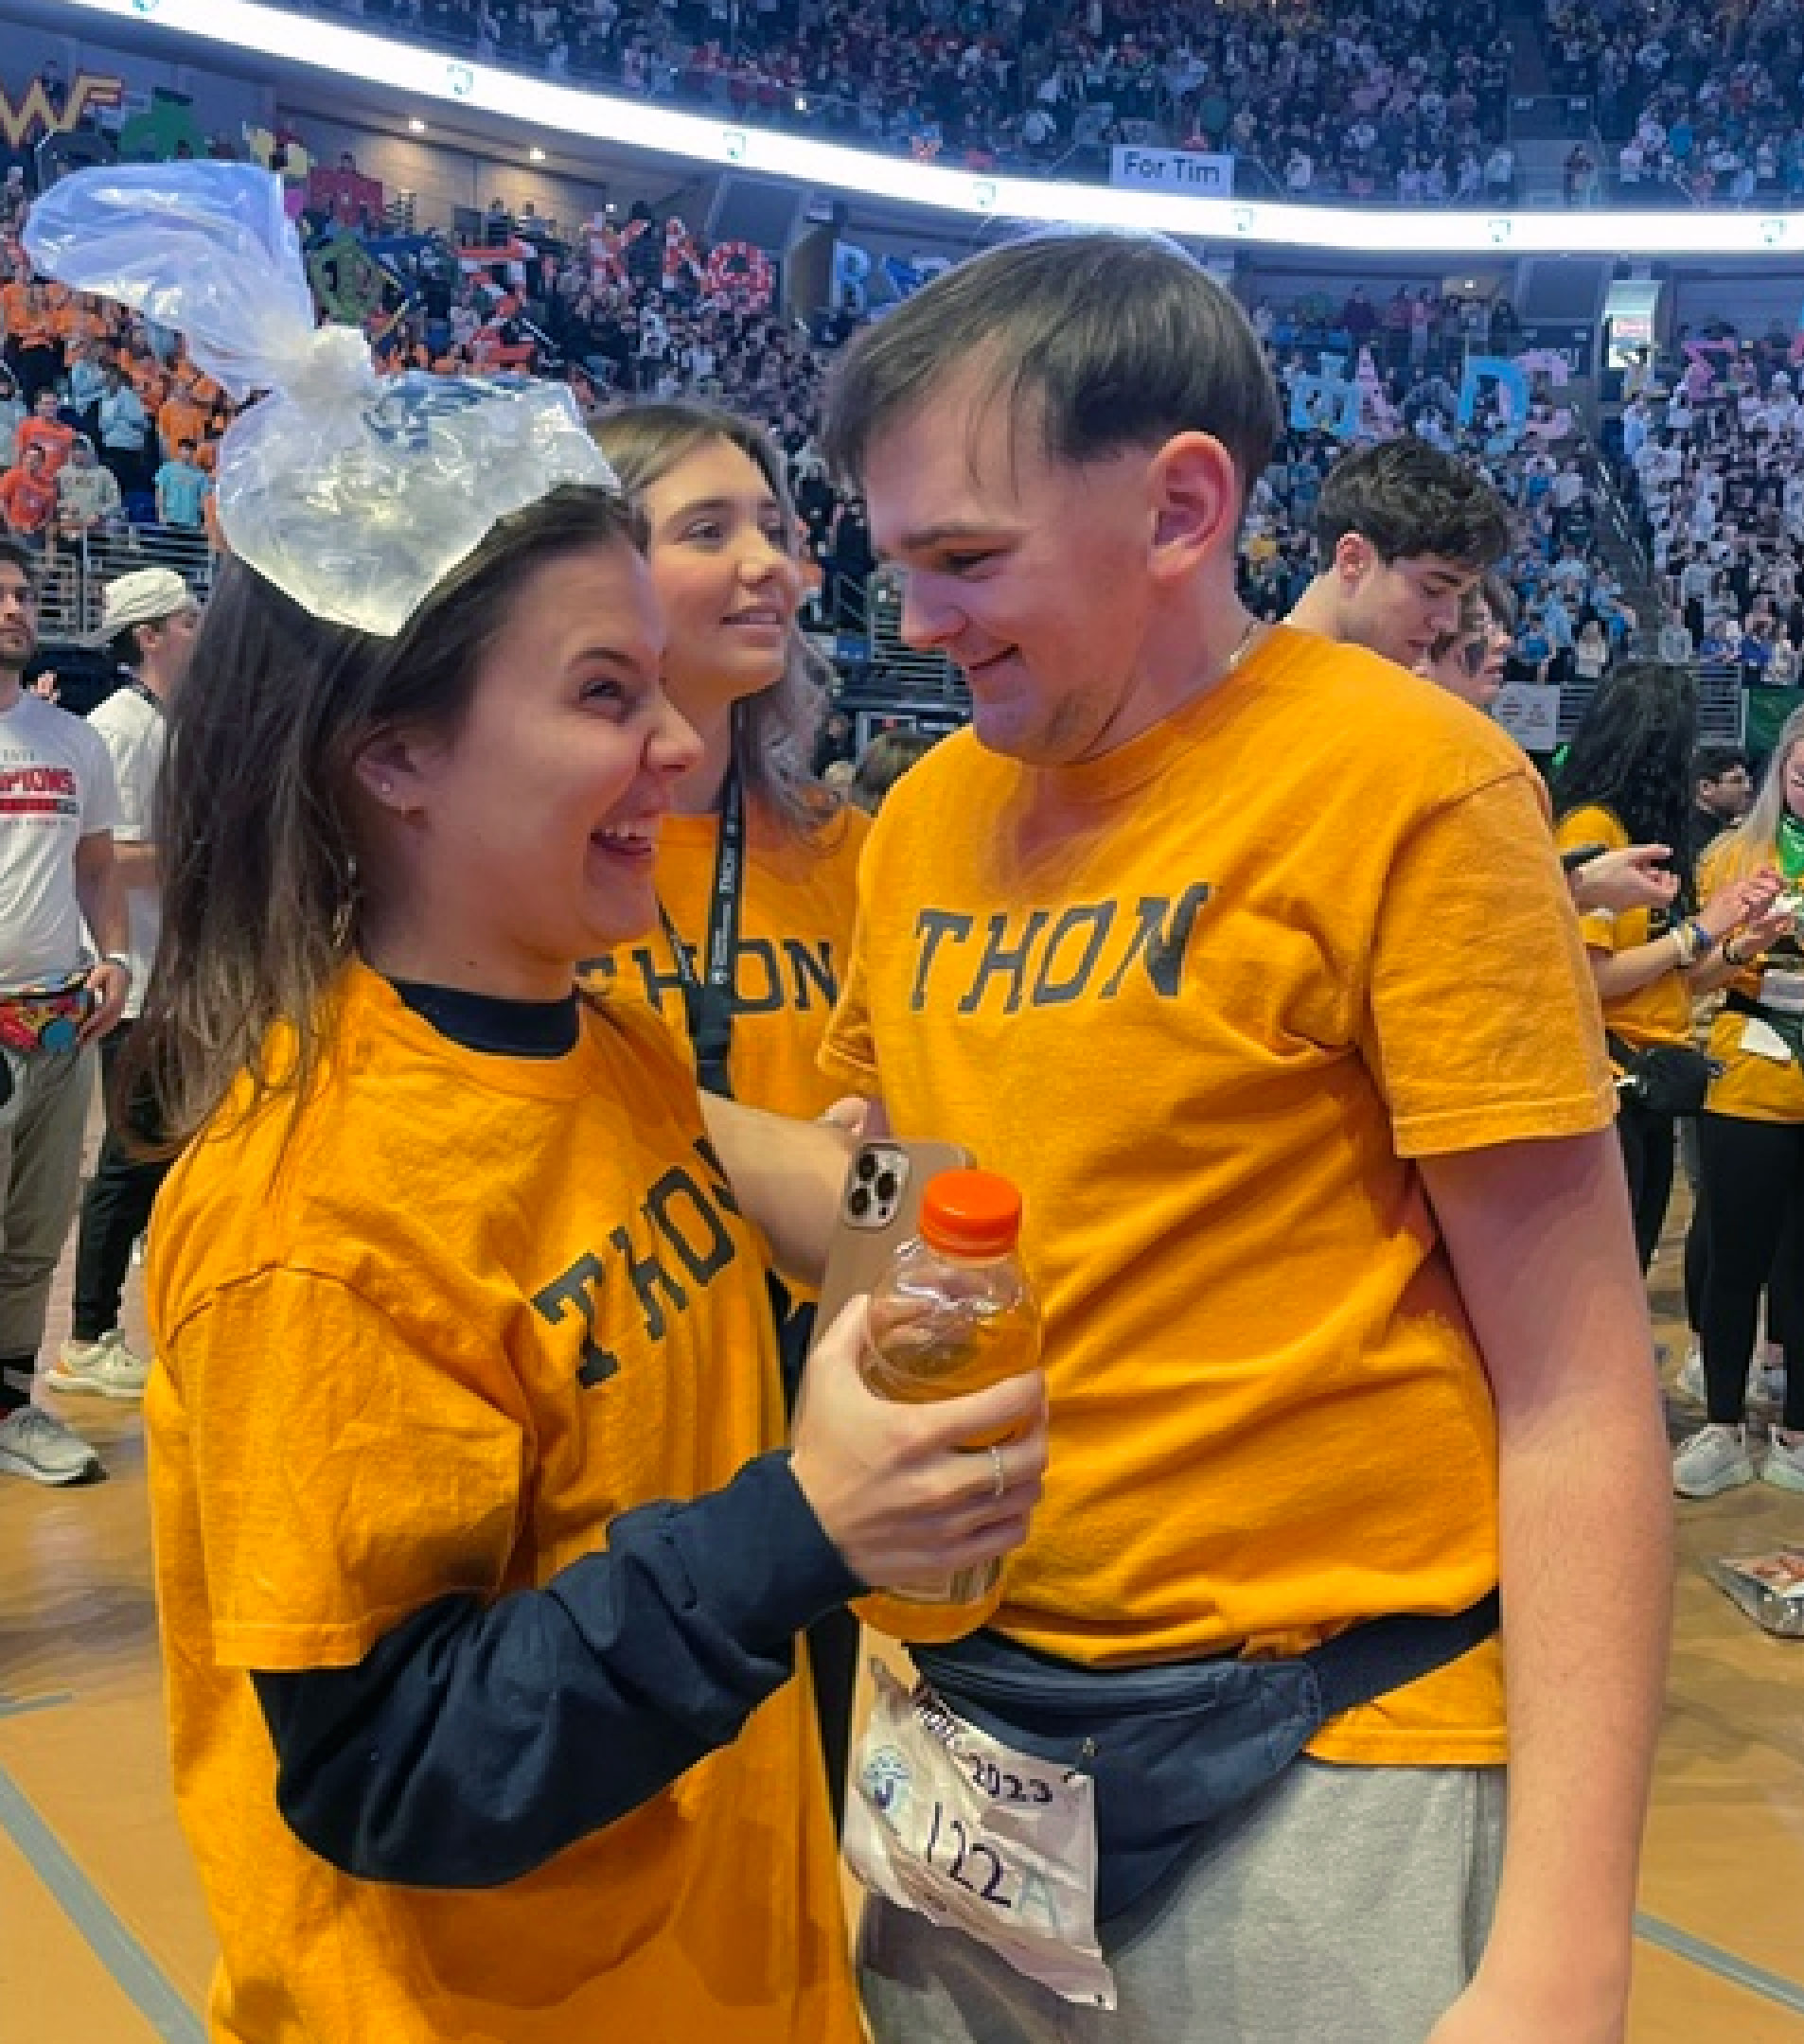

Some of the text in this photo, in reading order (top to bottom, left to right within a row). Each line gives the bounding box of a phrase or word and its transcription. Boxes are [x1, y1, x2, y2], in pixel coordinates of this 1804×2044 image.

[1123, 150, 1220, 185] For Tim
[910, 882, 1210, 1015] THON
[965, 1753, 1053, 1803] 2023
